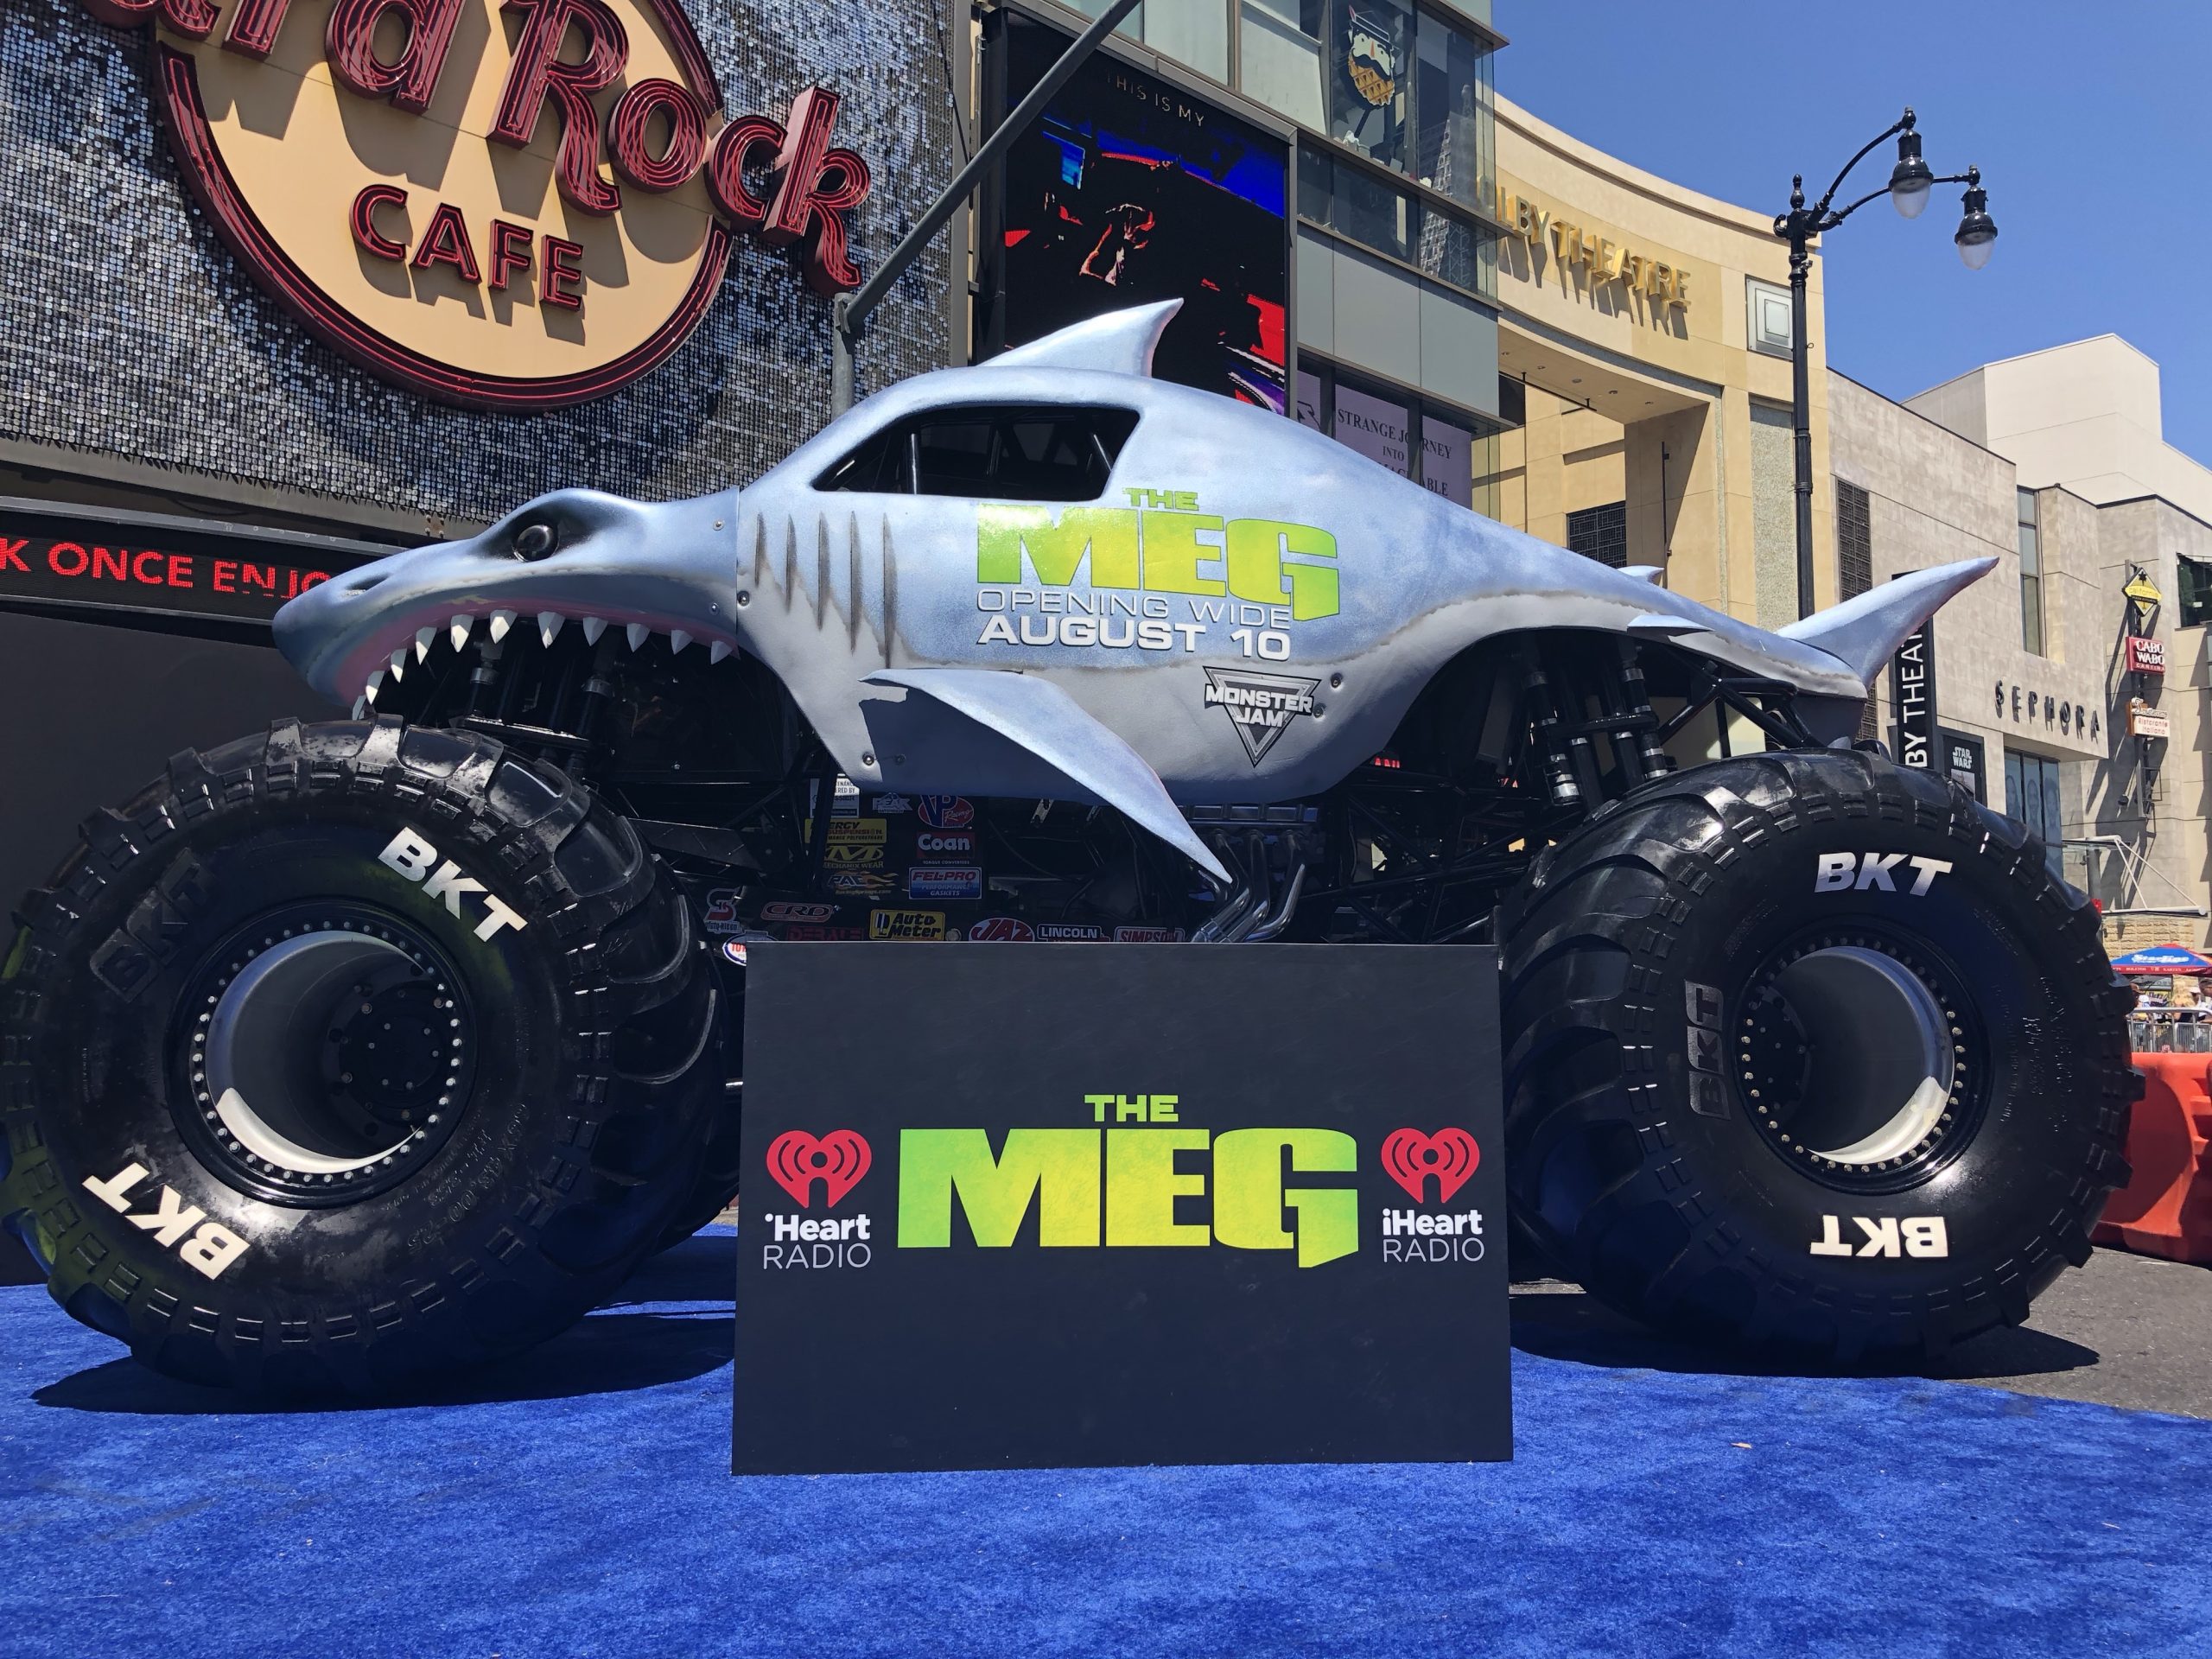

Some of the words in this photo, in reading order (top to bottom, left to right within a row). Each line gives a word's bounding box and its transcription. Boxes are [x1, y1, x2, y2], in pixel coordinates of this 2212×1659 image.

[1155, 92, 1171, 111] IS
[1179, 104, 1205, 127] MY
[348, 183, 585, 312] CAFE
[1550, 219, 1691, 308] THEATRE
[1338, 408, 1396, 441] STRANGE
[1398, 429, 1452, 460] JRNEY
[1382, 445, 1405, 462] INTO
[1124, 487, 1199, 511] THE
[48, 542, 194, 588] ONCE
[977, 503, 1340, 622] MEG
[977, 588, 1169, 618] OPENING
[1189, 600, 1291, 630] WIDE
[977, 614, 1206, 652] AUGUST
[1230, 628, 1291, 662] 10
[2136, 640, 2164, 654] CABO
[2136, 652, 2164, 665] WABO
[2136, 663, 2165, 671] CANTINA
[1205, 684, 1313, 715] MONSTER
[1995, 679, 2101, 732] SEPHORA
[1236, 707, 1285, 728] JAM
[1952, 746, 1973, 760] STAR
[1953, 757, 1973, 770] WARS
[918, 833, 970, 851] Coan
[378, 827, 528, 944] BKT
[1814, 851, 1953, 896] BKT
[766, 904, 831, 916] CRD
[893, 912, 937, 925] Auto
[890, 924, 941, 938] Meter
[1041, 926, 1098, 939] LINCOLN
[1683, 980, 1731, 1120] BKT
[1084, 1095, 1179, 1122] THE
[898, 1128, 1359, 1268] MEG
[82, 1162, 251, 1280] BKT
[765, 1213, 871, 1242] Heart
[1382, 1208, 1483, 1237] iHeart
[1382, 1237, 1485, 1263] RADIO
[1810, 1214, 1948, 1258] BKT
[763, 1243, 872, 1269] RADIO
